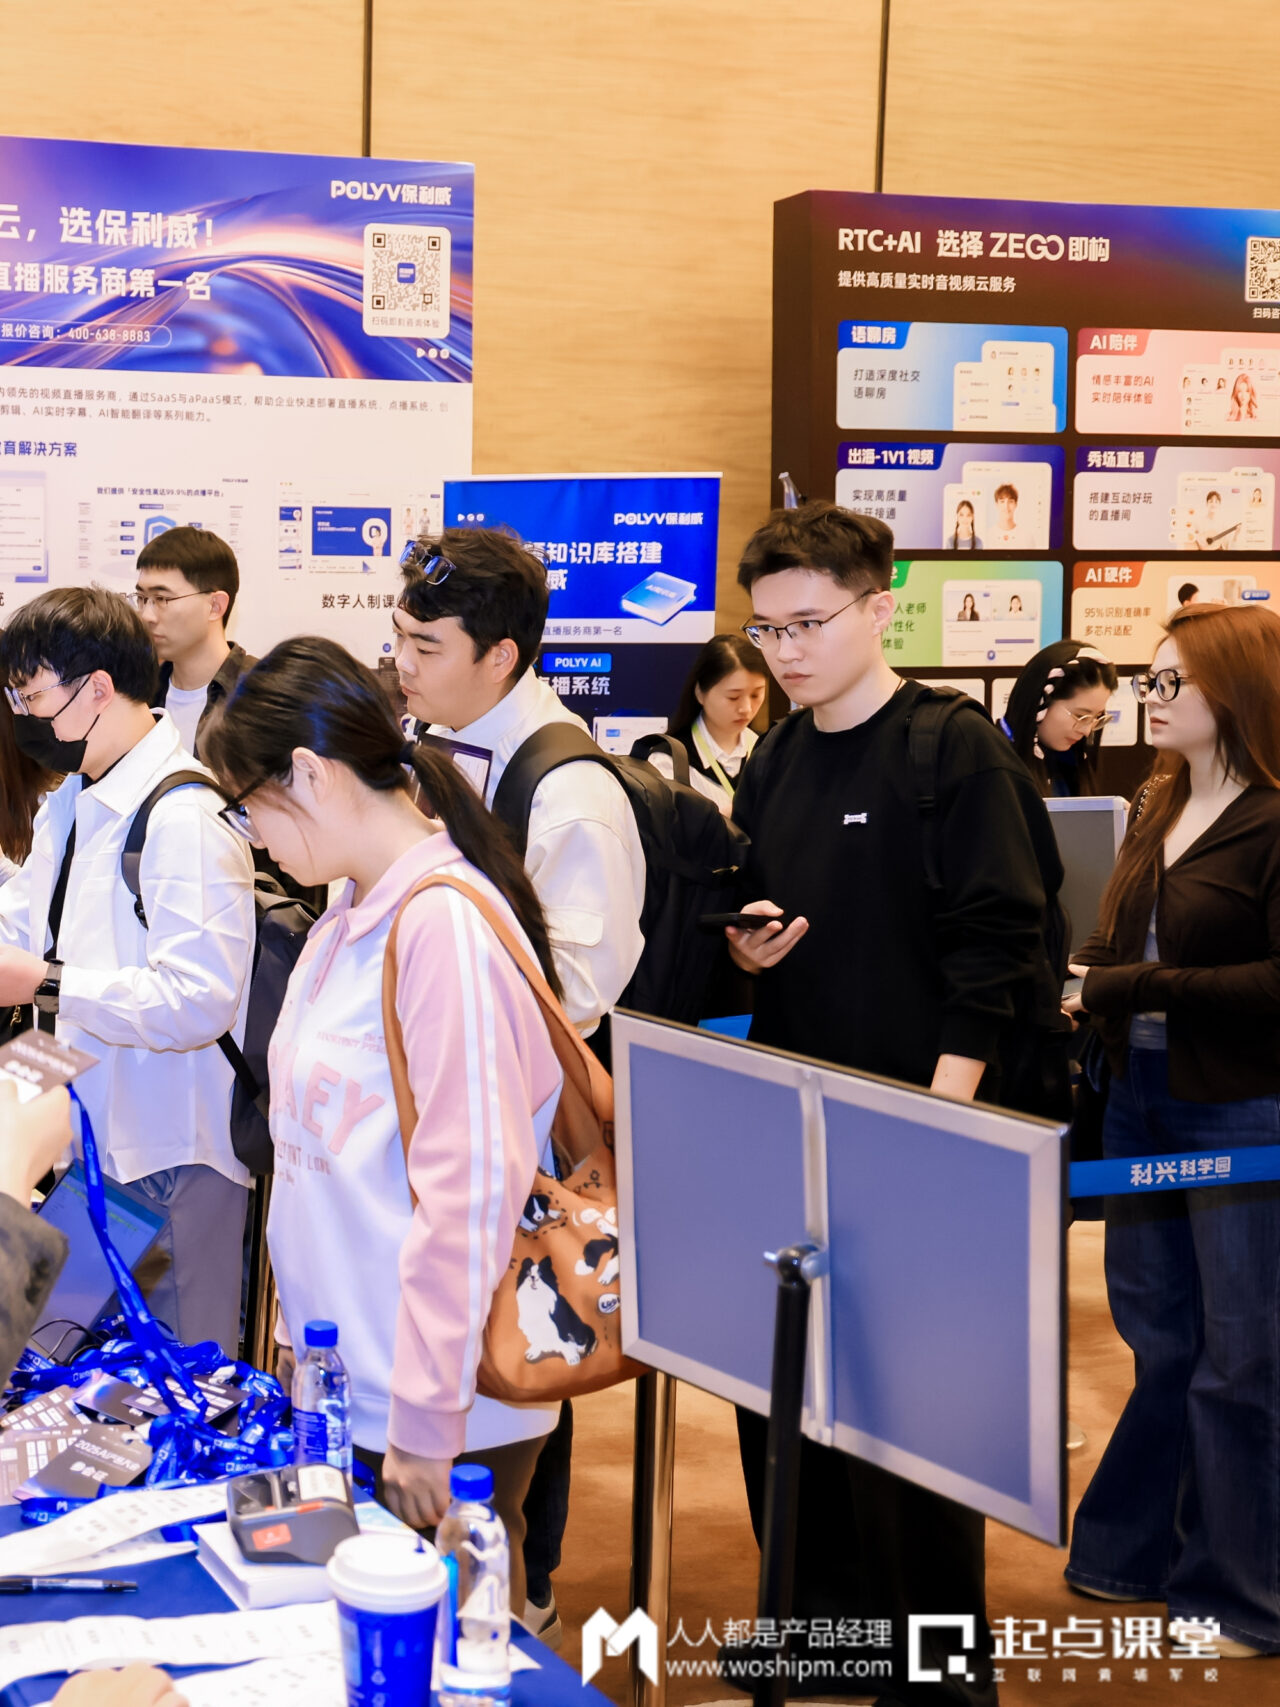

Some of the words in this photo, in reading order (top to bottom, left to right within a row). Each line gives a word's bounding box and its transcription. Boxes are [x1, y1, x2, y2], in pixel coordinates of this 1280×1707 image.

[331, 180, 452, 205] POLYV保利威
[838, 228, 921, 254] RTC+AI
[937, 230, 984, 259] 选择
[1068, 236, 1110, 262] 即构
[838, 270, 1016, 293] 提供高质量实时音视频云服务
[851, 325, 897, 344] 语聊房
[1090, 334, 1107, 350] AI
[1109, 334, 1138, 351] 陪伴
[853, 369, 920, 382] 打造深度社交
[854, 386, 887, 399] 语聊房
[907, 449, 934, 465] 视频
[1087, 451, 1145, 468] 秀场直播
[852, 490, 907, 502] 实现高质量
[1089, 492, 1153, 505] 搭建互动好玩
[614, 512, 703, 525] POLYV保利威
[1089, 509, 1131, 521] 的直播间
[1085, 568, 1102, 583] AI
[1104, 566, 1132, 583] 硬件
[555, 657, 588, 667] POLYV
[590, 657, 602, 667] AI
